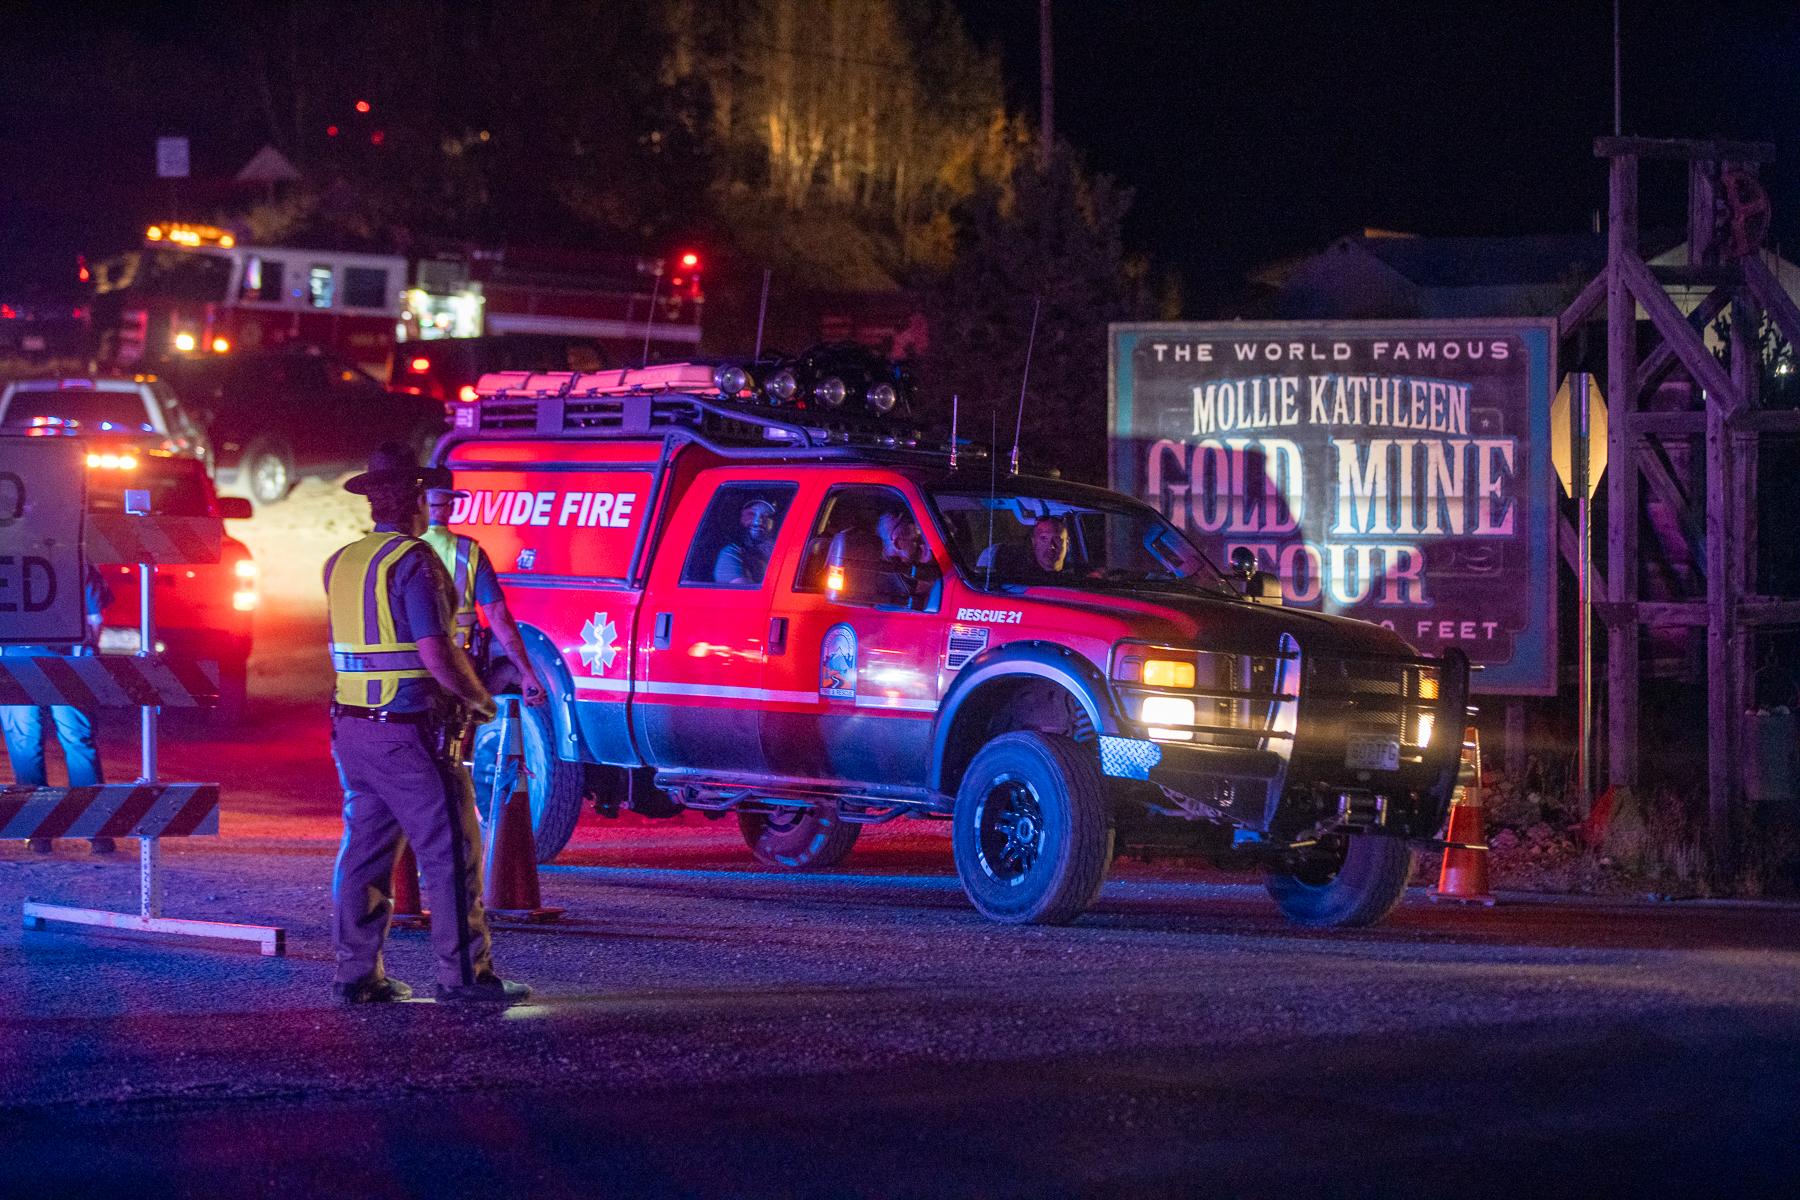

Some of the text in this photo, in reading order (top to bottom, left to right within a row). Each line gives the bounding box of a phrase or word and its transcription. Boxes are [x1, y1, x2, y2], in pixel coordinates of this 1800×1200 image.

[1154, 342, 1510, 362] THE WORLD FAMOUS
[1192, 376, 1470, 436] MOLLIE KATHLEEN
[1149, 438, 1515, 535] GOLD MINE
[447, 489, 637, 529] DIVIDE FIRE
[1417, 620, 1498, 639] FEET
